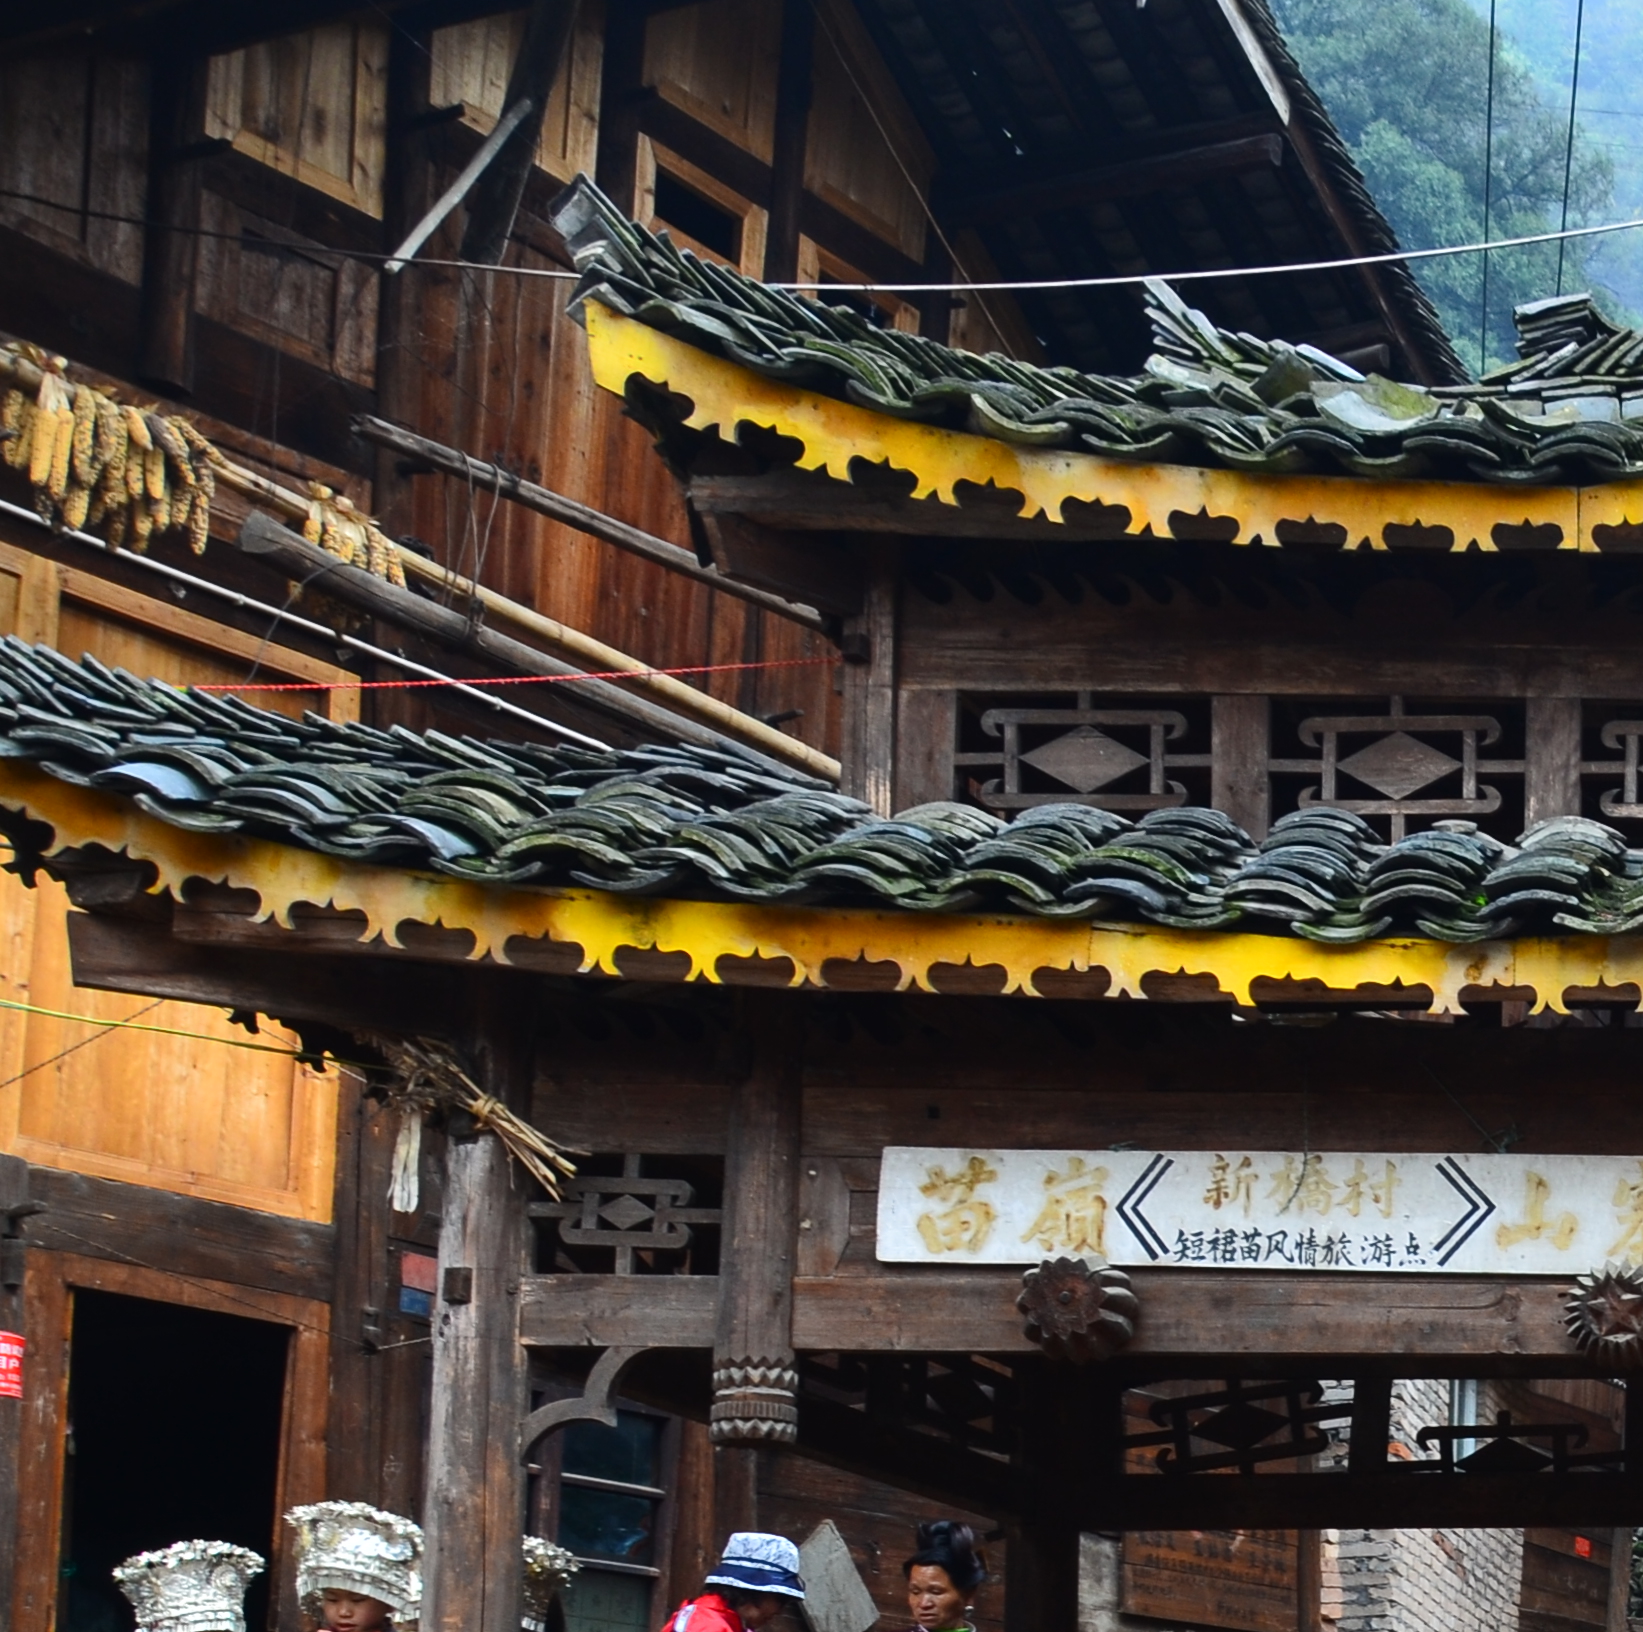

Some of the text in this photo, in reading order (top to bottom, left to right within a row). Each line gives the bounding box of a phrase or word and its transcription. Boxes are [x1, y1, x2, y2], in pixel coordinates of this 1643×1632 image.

[1203, 1153, 1401, 1218] 新橋村
[1173, 1227, 1428, 1267] 短裙苗风情旅游点
